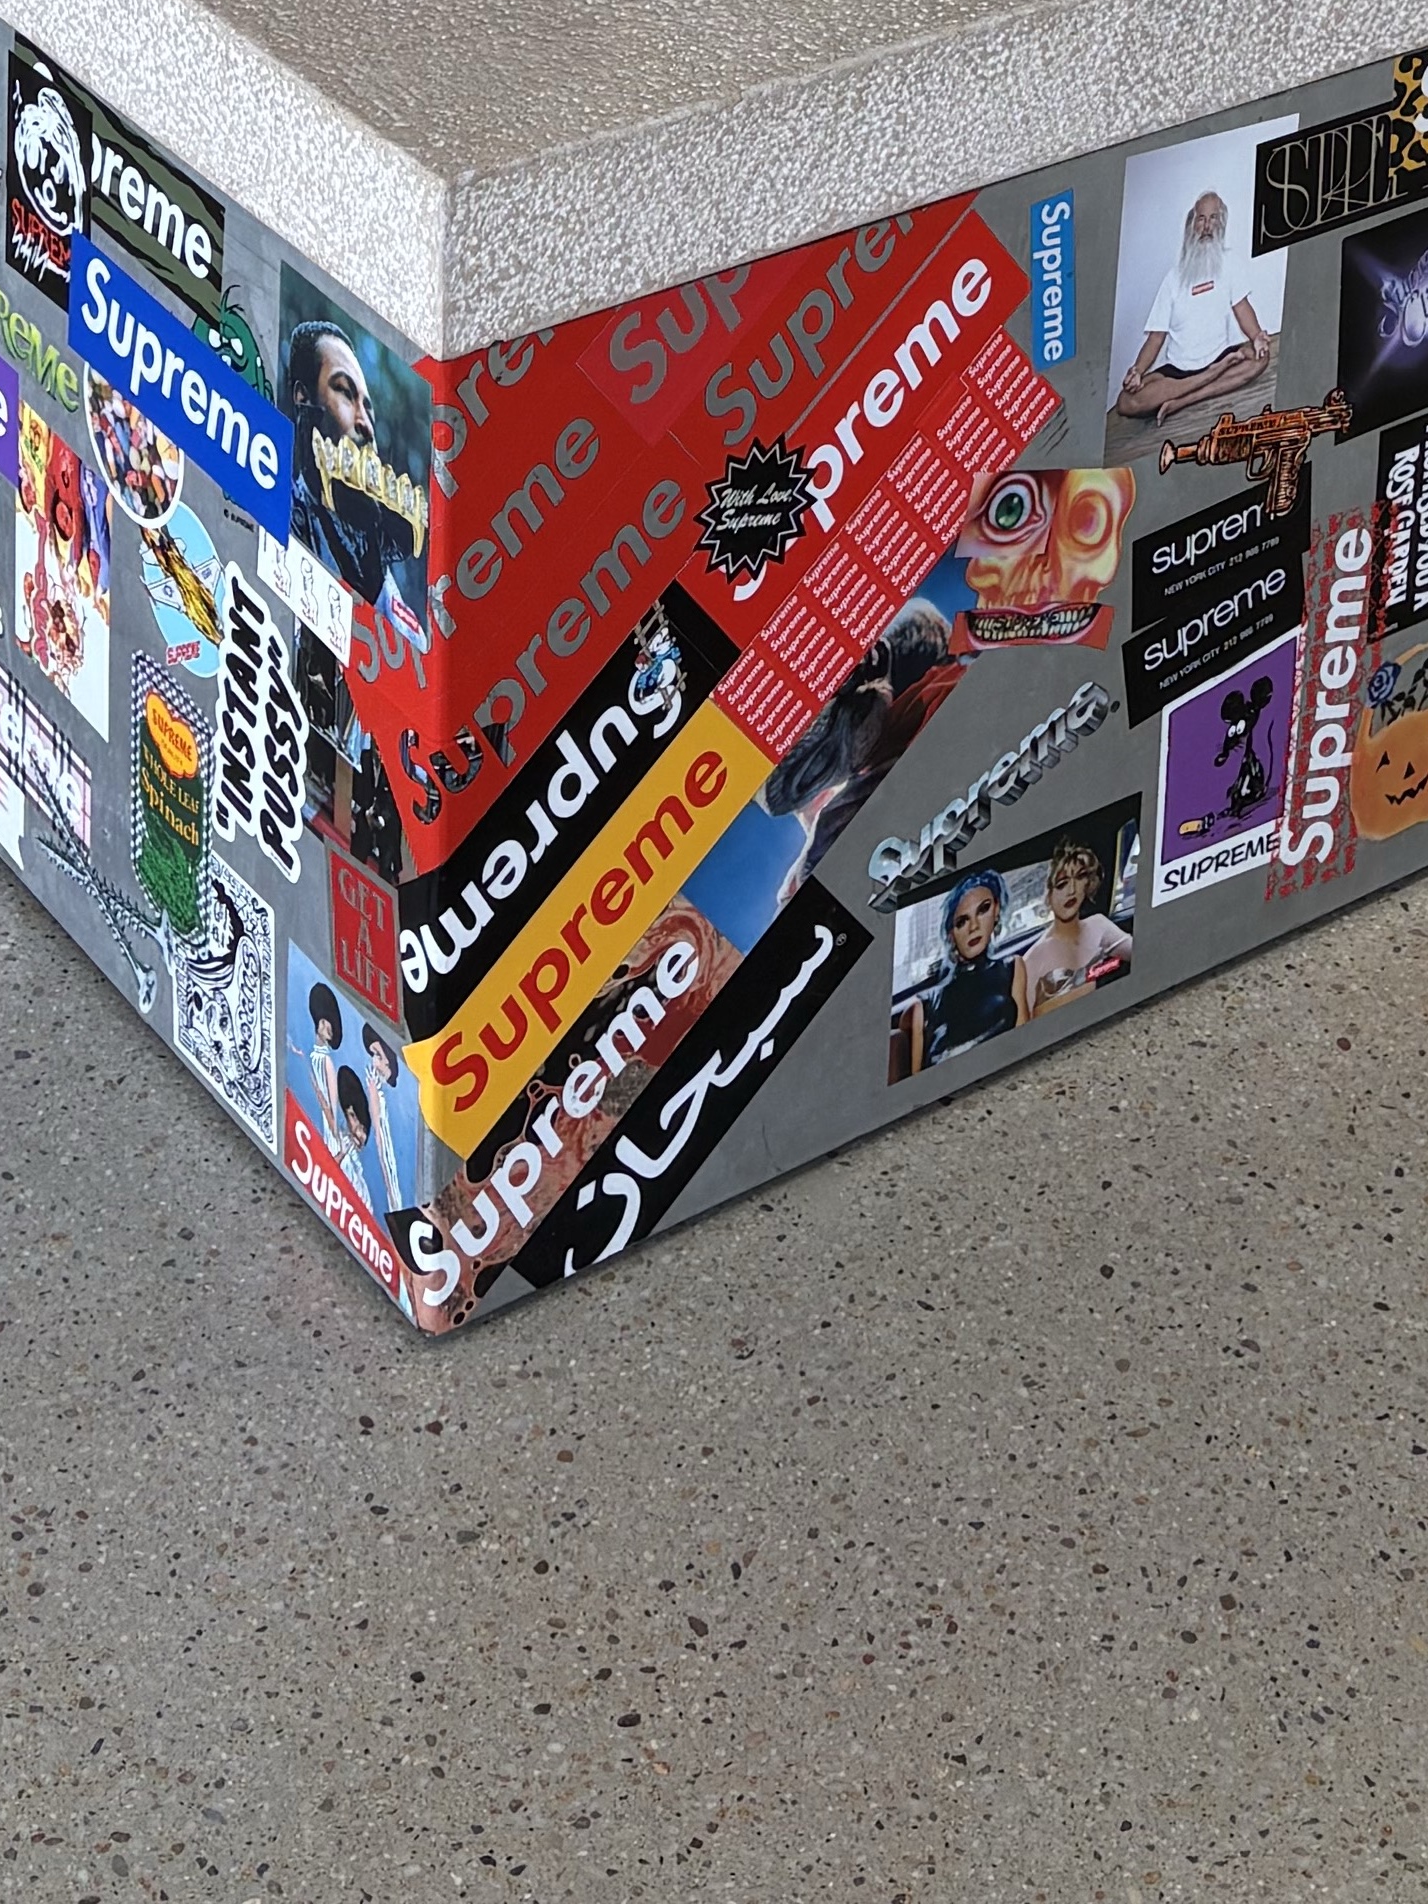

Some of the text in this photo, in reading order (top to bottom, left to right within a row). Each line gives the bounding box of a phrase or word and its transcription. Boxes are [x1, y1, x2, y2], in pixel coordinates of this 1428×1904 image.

[11, 197, 71, 269] SUPREM
[90, 132, 213, 279] reme
[1039, 198, 1072, 363] Supreme
[80, 258, 280, 490] Supreme
[720, 483, 759, 509] With
[1385, 443, 1419, 506] ROSE
[716, 508, 782, 534] Supreme
[1143, 568, 1288, 672] supreme
[152, 707, 194, 764] SUPREME
[1279, 527, 1372, 868] Supreme
[141, 768, 200, 847] Spinach
[866, 680, 1112, 915] Supreme
[336, 866, 387, 931] GET
[1160, 832, 1281, 894] SUPREME
[340, 938, 393, 1011] LIFE
[432, 748, 728, 1113] Supreme
[408, 941, 700, 1307] Supreme
[291, 1119, 395, 1285] Supreme
